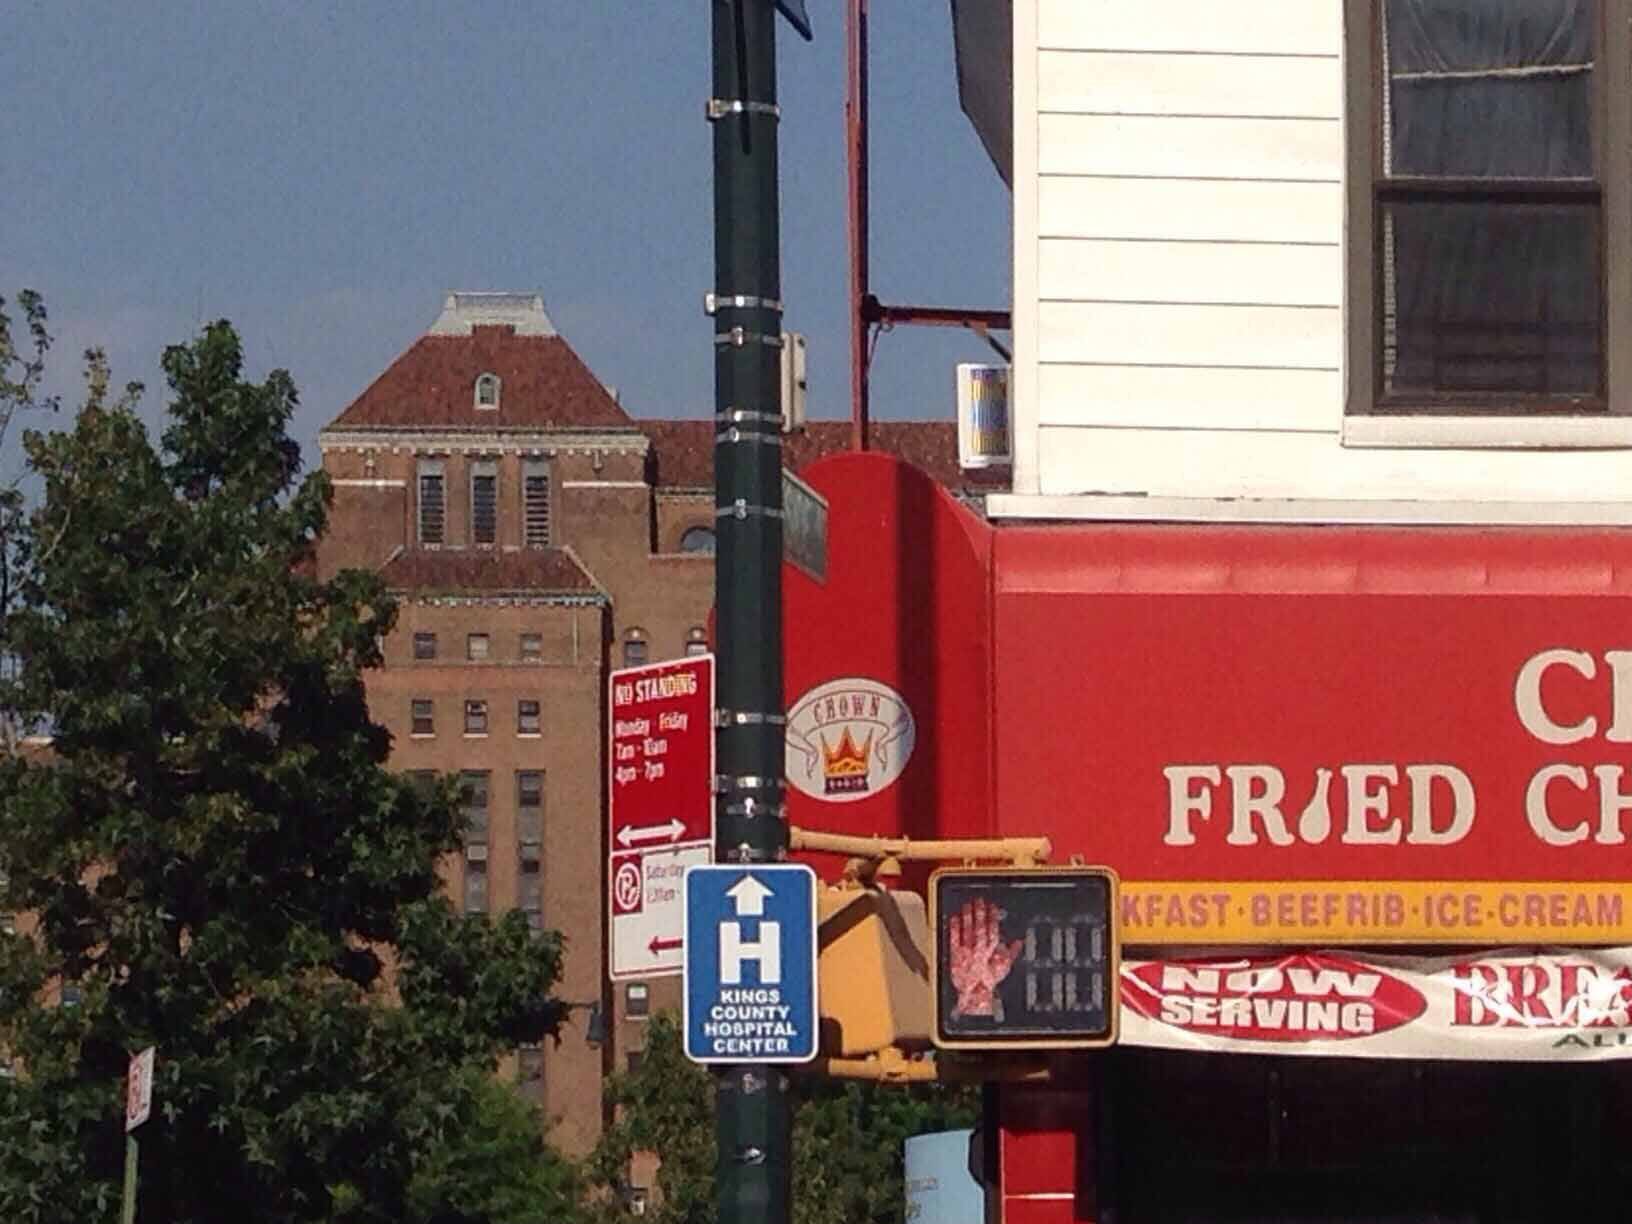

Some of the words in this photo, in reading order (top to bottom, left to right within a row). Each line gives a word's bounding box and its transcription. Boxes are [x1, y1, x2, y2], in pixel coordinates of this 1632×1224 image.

[615, 683, 633, 705] NO
[635, 672, 697, 703] STANDING
[659, 711, 688, 732] Friday
[813, 693, 881, 724] CROWN
[1163, 763, 1476, 846] FRIED
[1497, 894, 1623, 928] CREAM
[719, 920, 781, 985] H
[720, 988, 781, 1004] KINGS
[1162, 965, 1383, 997] NOW
[711, 1005, 791, 1020] COUNTY
[1161, 995, 1376, 1033] SERVING
[704, 1021, 798, 1038] HOSPITAL
[713, 1037, 789, 1053] CENTER
